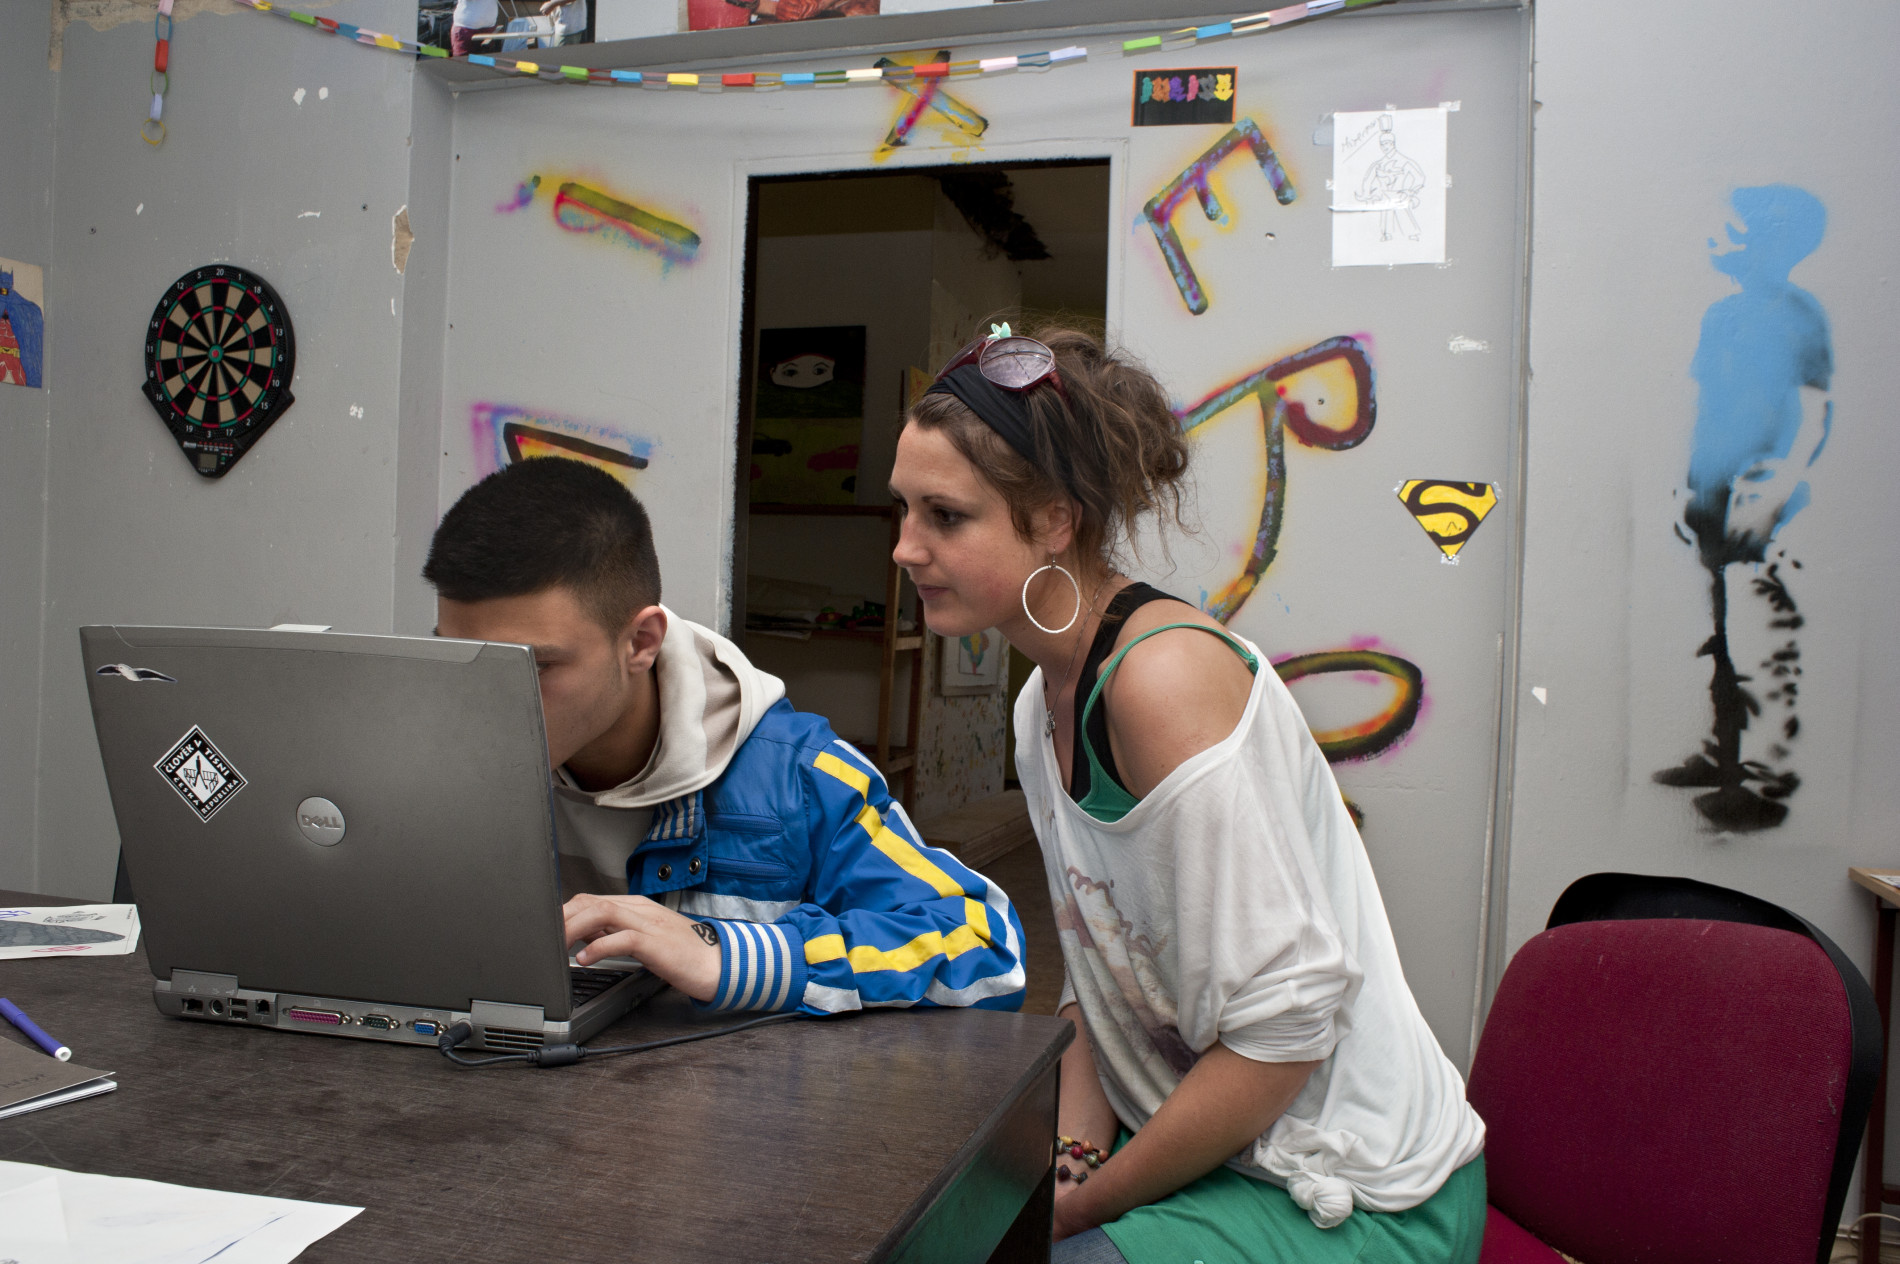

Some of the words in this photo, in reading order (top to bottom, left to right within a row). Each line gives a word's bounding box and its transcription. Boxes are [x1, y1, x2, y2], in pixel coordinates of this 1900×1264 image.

[254, 286, 262, 294] 18
[163, 744, 194, 773] ČLOVĚK
[194, 740, 202, 748] V
[200, 779, 238, 814] REPUBLIKA
[302, 814, 341, 829] DELL
